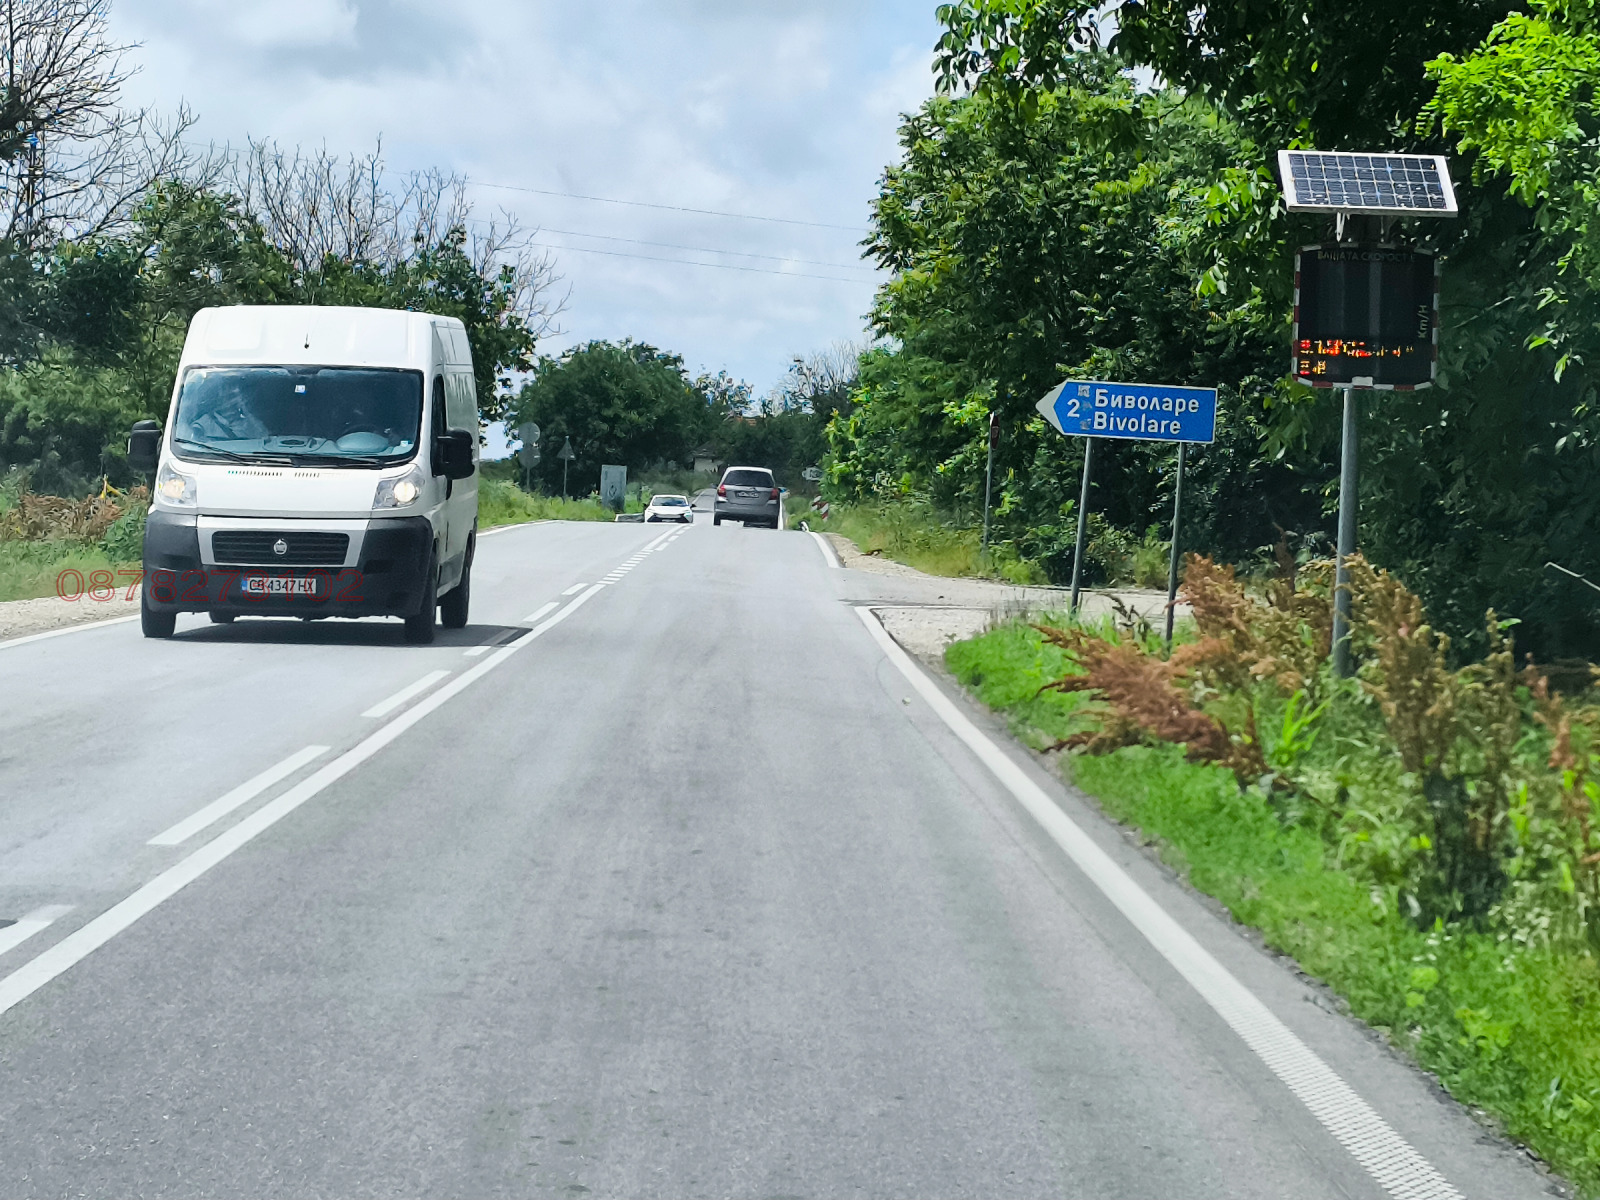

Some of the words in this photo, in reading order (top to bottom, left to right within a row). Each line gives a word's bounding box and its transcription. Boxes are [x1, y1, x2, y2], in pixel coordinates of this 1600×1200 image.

[1066, 398, 1081, 418] 2
[1094, 388, 1200, 417] Биволаре
[1093, 411, 1182, 435] Bivolare
